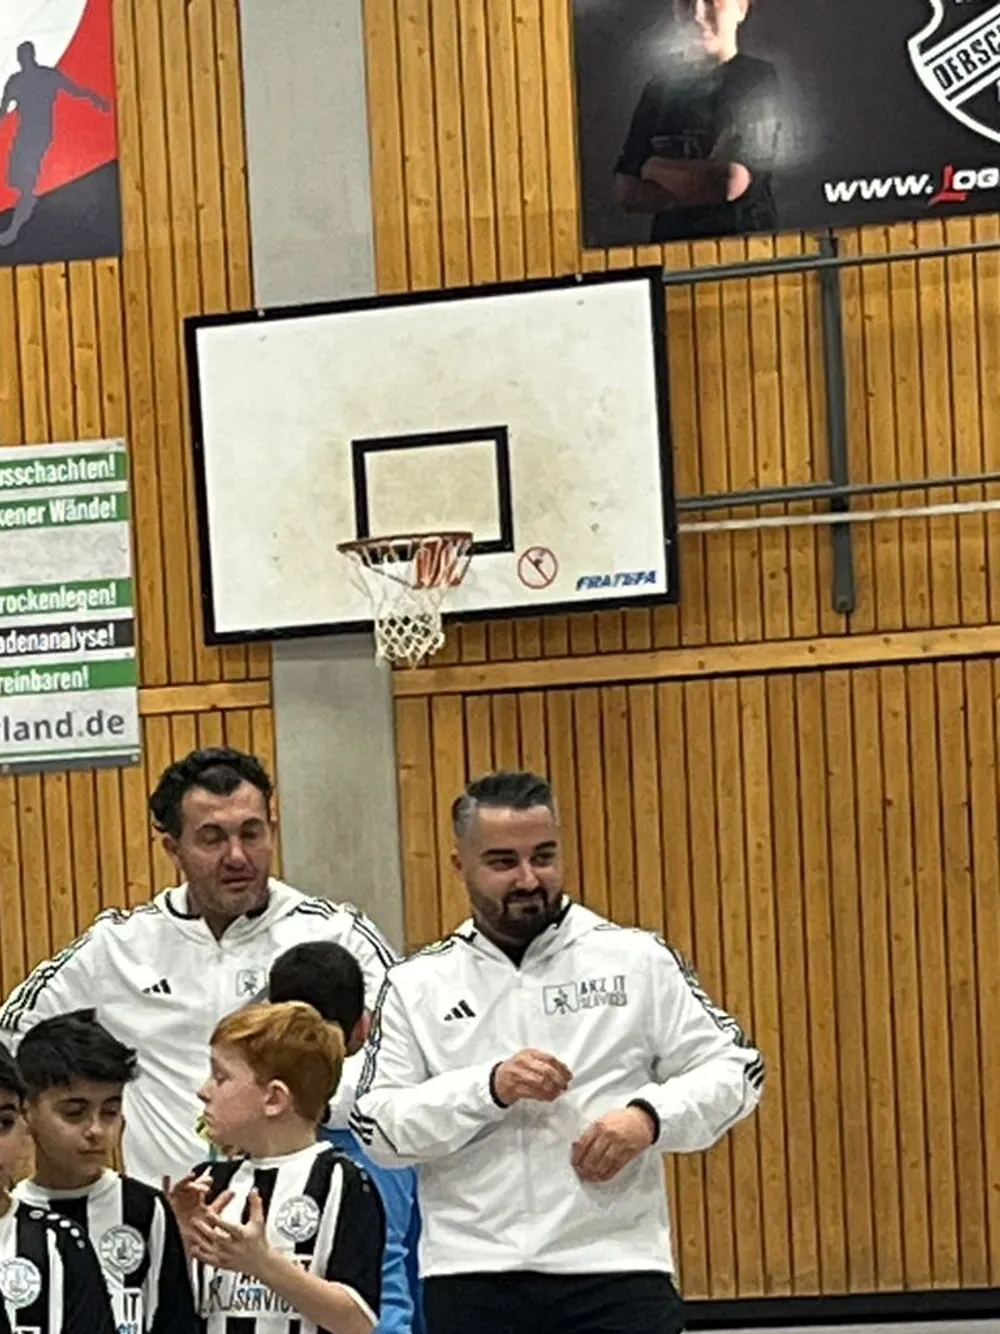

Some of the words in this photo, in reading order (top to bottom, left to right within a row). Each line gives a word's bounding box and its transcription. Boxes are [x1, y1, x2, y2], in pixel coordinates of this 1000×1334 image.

[932, 25, 1000, 91] DERSC
[49, 495, 117, 523] Wände!
[236, 1287, 299, 1314] SERVIC
